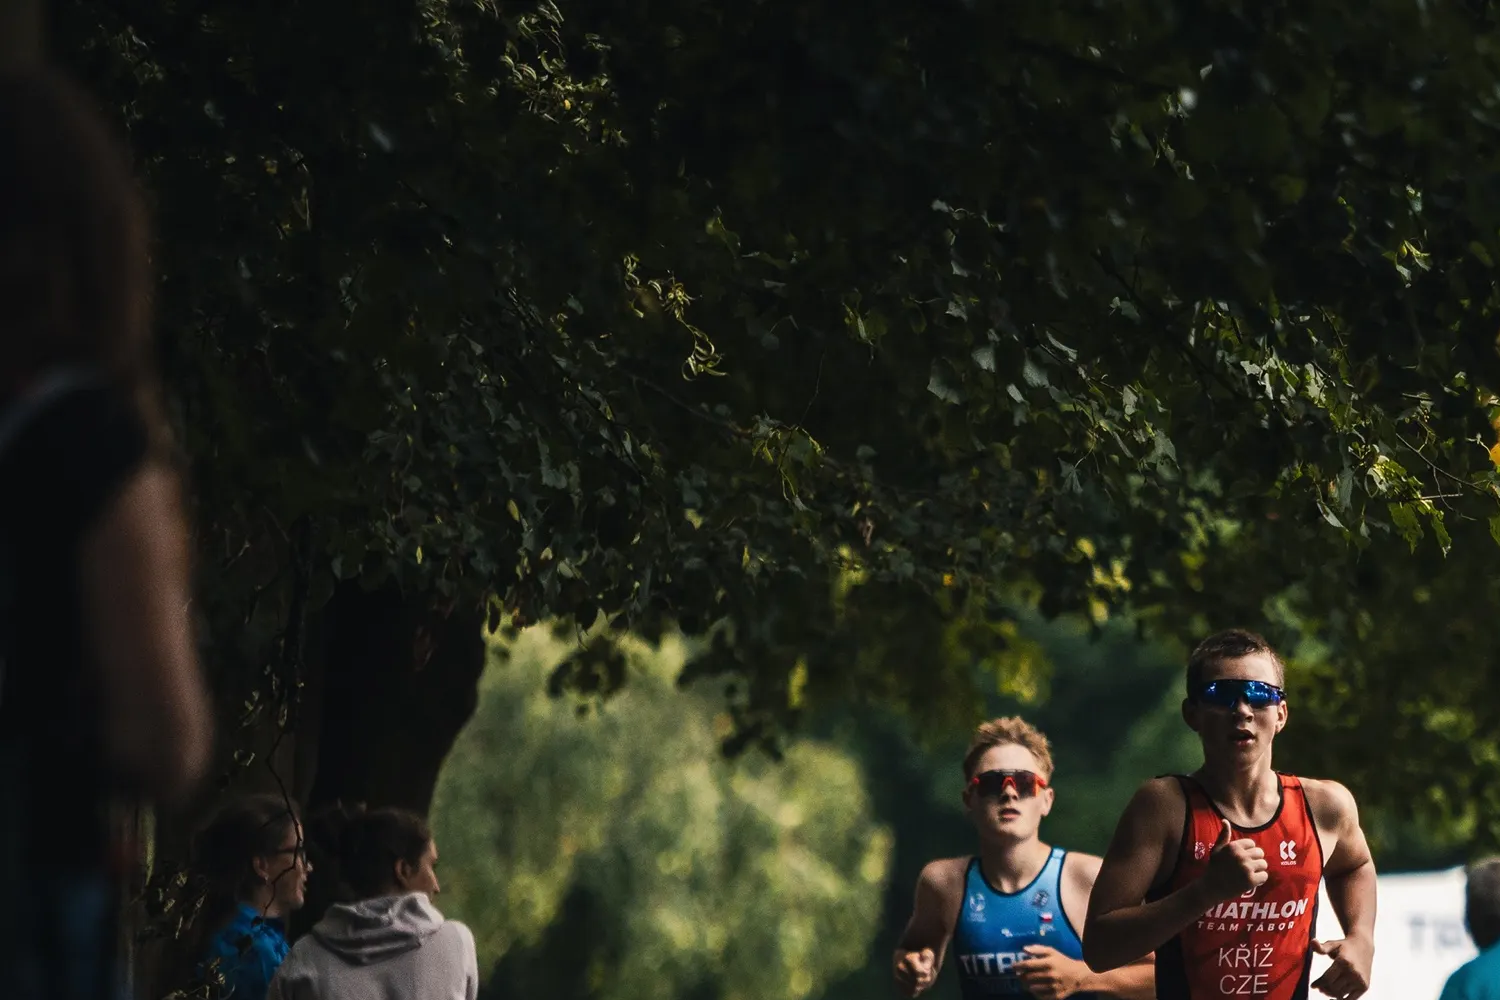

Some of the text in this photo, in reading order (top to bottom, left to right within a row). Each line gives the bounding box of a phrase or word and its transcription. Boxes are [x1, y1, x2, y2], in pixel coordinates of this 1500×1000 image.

[1202, 898, 1308, 919] RIATHLON
[1197, 920, 1294, 932] TEAM TÁBOR
[1218, 943, 1274, 968] KŘÍŽ
[1219, 973, 1269, 994] CZE
